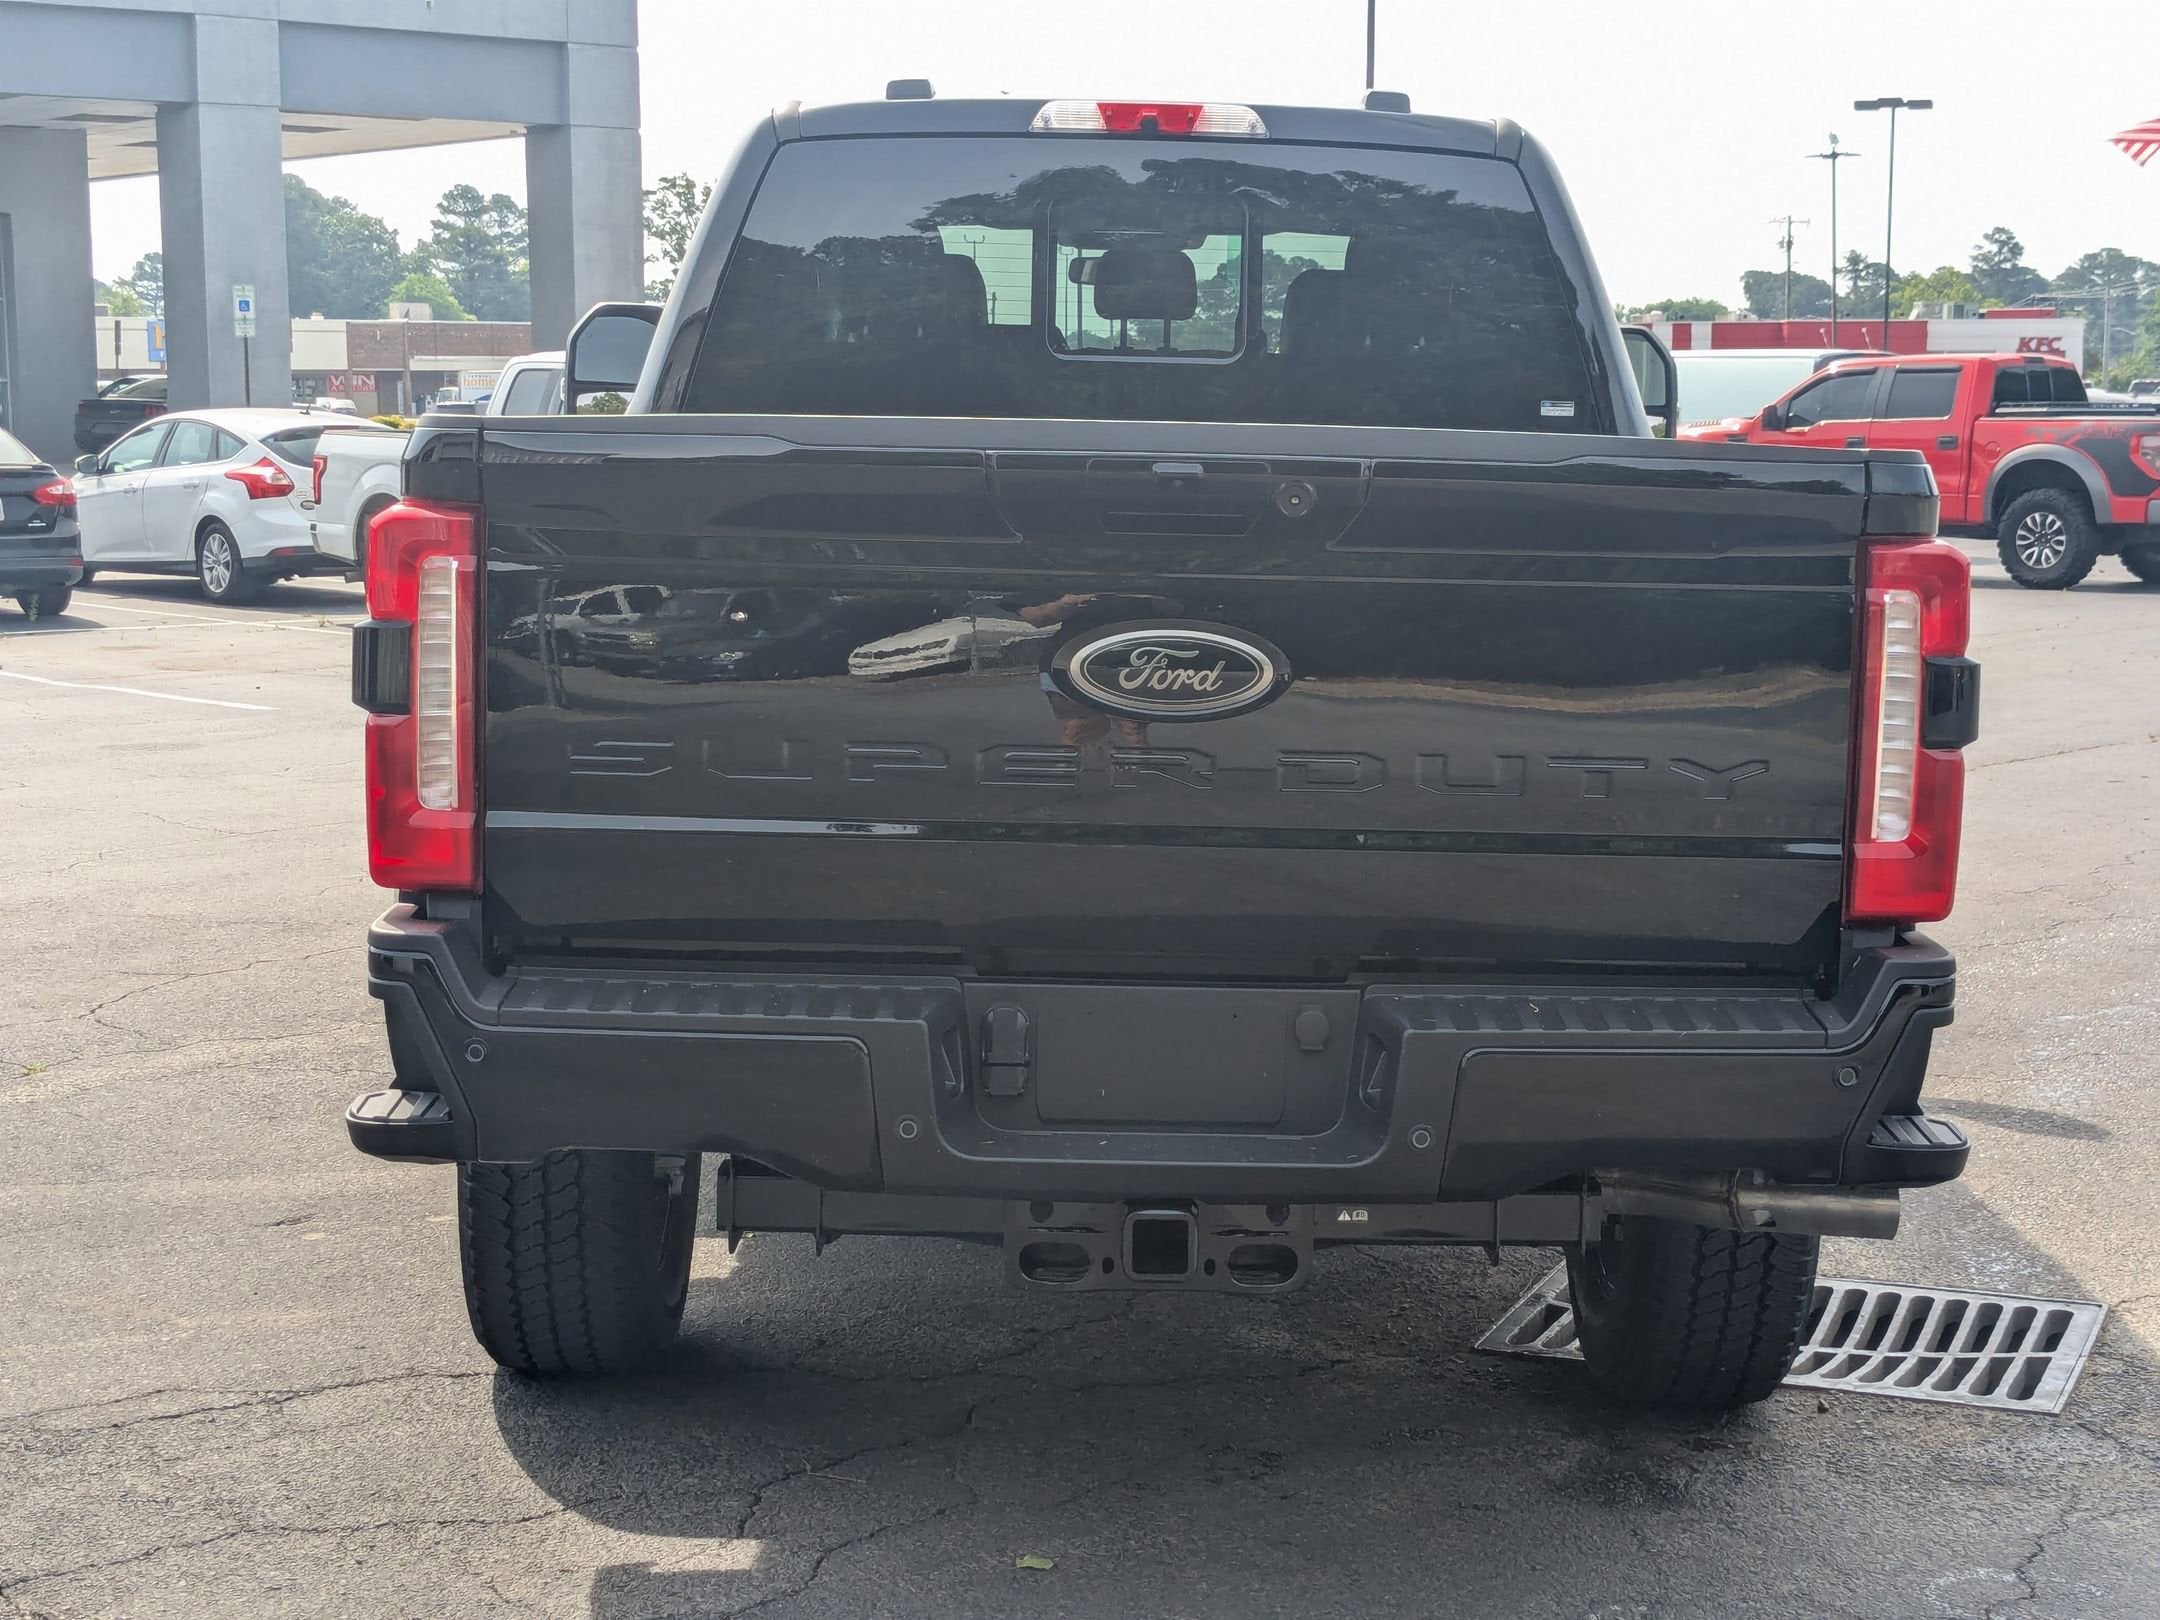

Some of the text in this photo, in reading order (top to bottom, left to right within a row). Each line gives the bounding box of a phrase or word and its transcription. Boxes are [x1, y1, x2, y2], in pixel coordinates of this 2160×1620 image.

[2016, 336, 2062, 352] KFC
[1119, 646, 1226, 691] Ford
[568, 739, 1770, 800] SUPER DUTY
